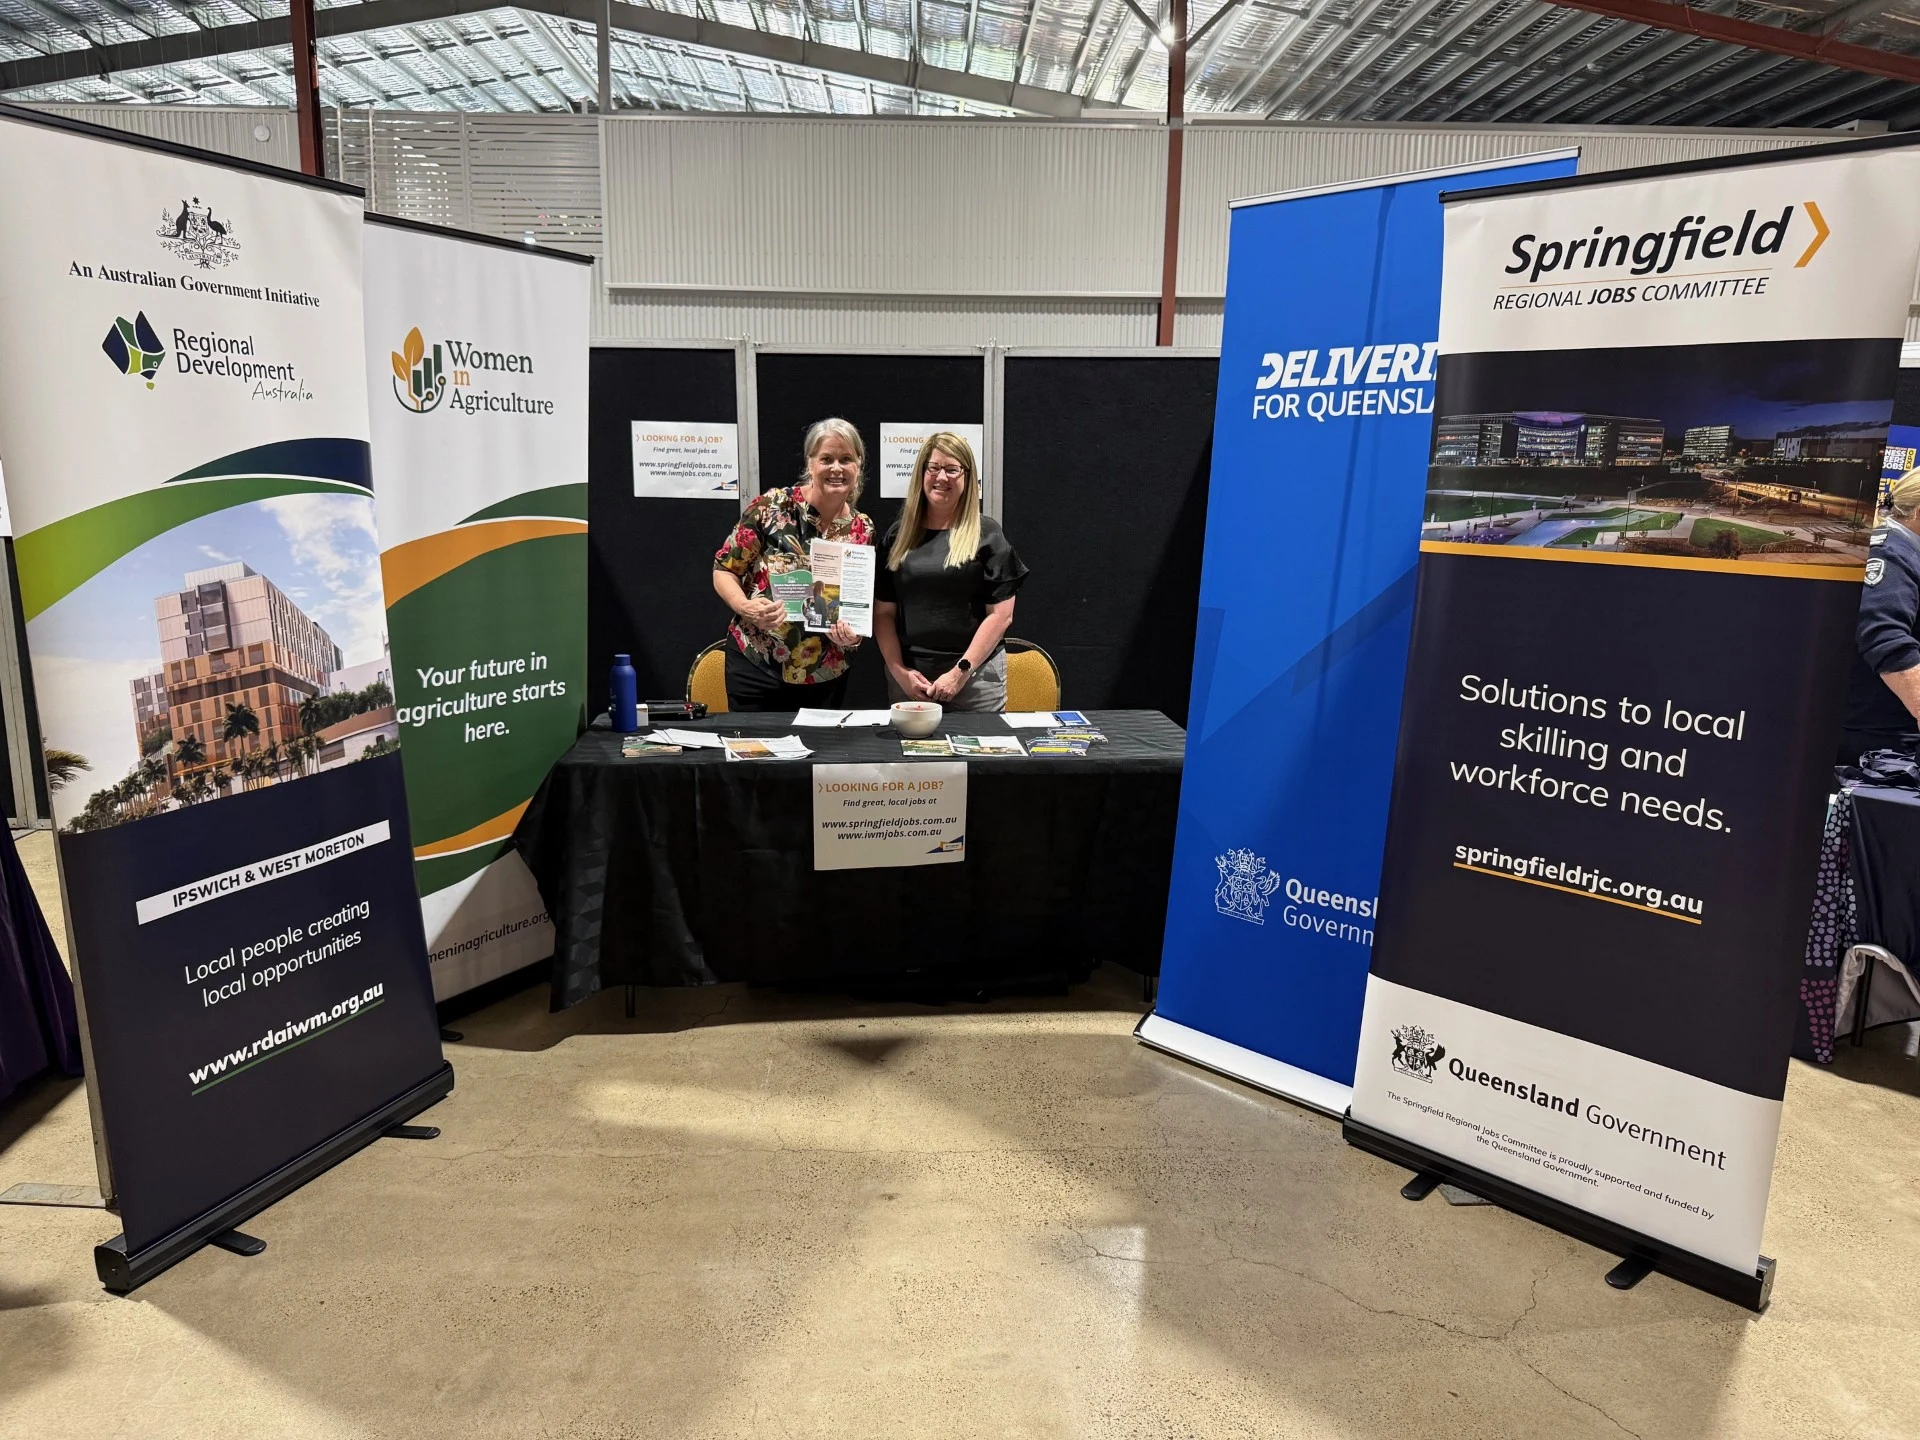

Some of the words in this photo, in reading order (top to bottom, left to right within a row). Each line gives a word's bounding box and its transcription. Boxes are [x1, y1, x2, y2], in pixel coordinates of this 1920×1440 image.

[1504, 205, 1794, 282] Springfield
[69, 260, 93, 278] An
[98, 264, 176, 289] Australian
[180, 275, 263, 300] Government
[265, 287, 320, 308] Initiative
[1493, 289, 1584, 310] REGIONAL
[1587, 286, 1637, 305] JOBS
[1641, 276, 1770, 302] COMMITTEE
[173, 328, 254, 358] Regional
[445, 340, 534, 374] Women
[176, 352, 295, 383] Development
[453, 369, 471, 386] in
[1255, 341, 1438, 390] DELIVERI
[252, 378, 314, 402] Australia
[449, 388, 554, 415] Agriculture
[1252, 393, 1300, 420] FOR
[642, 434, 678, 443] LOOKING
[680, 435, 696, 443] FOR
[704, 436, 723, 445] JOB?
[698, 447, 709, 455] jobs
[888, 436, 924, 444] LOOKING
[639, 461, 733, 470] www.springfieldjobs.com.au
[650, 469, 722, 478] www.iwmjobs.com.au
[1882, 462, 1903, 470] JOBS
[1905, 450, 1914, 470] EXPO
[416, 666, 467, 689] Your
[470, 657, 526, 681] future
[530, 651, 548, 671] in
[396, 690, 507, 727] agriculture
[511, 679, 566, 704] starts
[1459, 674, 1608, 720] Solutions
[1618, 696, 1652, 726] to
[1663, 699, 1746, 741] local
[464, 720, 510, 743] here.
[1499, 722, 1609, 771] skilling
[1620, 748, 1688, 778] and
[825, 782, 879, 793] LOOKING
[882, 781, 905, 791] FOR
[907, 781, 916, 791] A
[917, 780, 944, 793] JOB?
[1450, 761, 1609, 808] workforce
[1620, 790, 1732, 834] needs.
[842, 799, 860, 807] Find
[861, 799, 886, 809] great,
[888, 798, 907, 806] local
[908, 797, 926, 807] jobs
[928, 797, 937, 805] at
[822, 816, 957, 830] www.springfieldjobs.com.au
[837, 828, 942, 841] www.iwmjobs.com.au
[172, 873, 241, 908] IPSWICH
[244, 870, 257, 882] &
[258, 855, 302, 878] WEST
[305, 833, 365, 865] MORETON
[1455, 843, 1704, 915] springfieldrjc.org.au
[184, 947, 236, 985] Local
[241, 926, 303, 967] people
[308, 900, 370, 937] creating
[203, 972, 246, 1008] local
[251, 930, 362, 987] opportunities
[188, 982, 384, 1085] www.rdaiwm.org.au
[1448, 1057, 1580, 1118] Queensland
[1585, 1104, 1727, 1172] Government
[1387, 1090, 1401, 1102] The
[1402, 1096, 1445, 1118] Springfield
[1445, 1112, 1481, 1132] Regional
[1481, 1126, 1500, 1140] Jobs
[1501, 1134, 1548, 1157] Committee
[1549, 1151, 1557, 1161] is
[1558, 1155, 1593, 1175] proudly
[1594, 1168, 1642, 1192] supported
[1643, 1187, 1663, 1200] and
[1664, 1194, 1700, 1214] funded
[1701, 1208, 1715, 1220] by
[1476, 1134, 1490, 1146] the
[1491, 1140, 1541, 1166] Queensland
[1542, 1160, 1600, 1188] Government.
